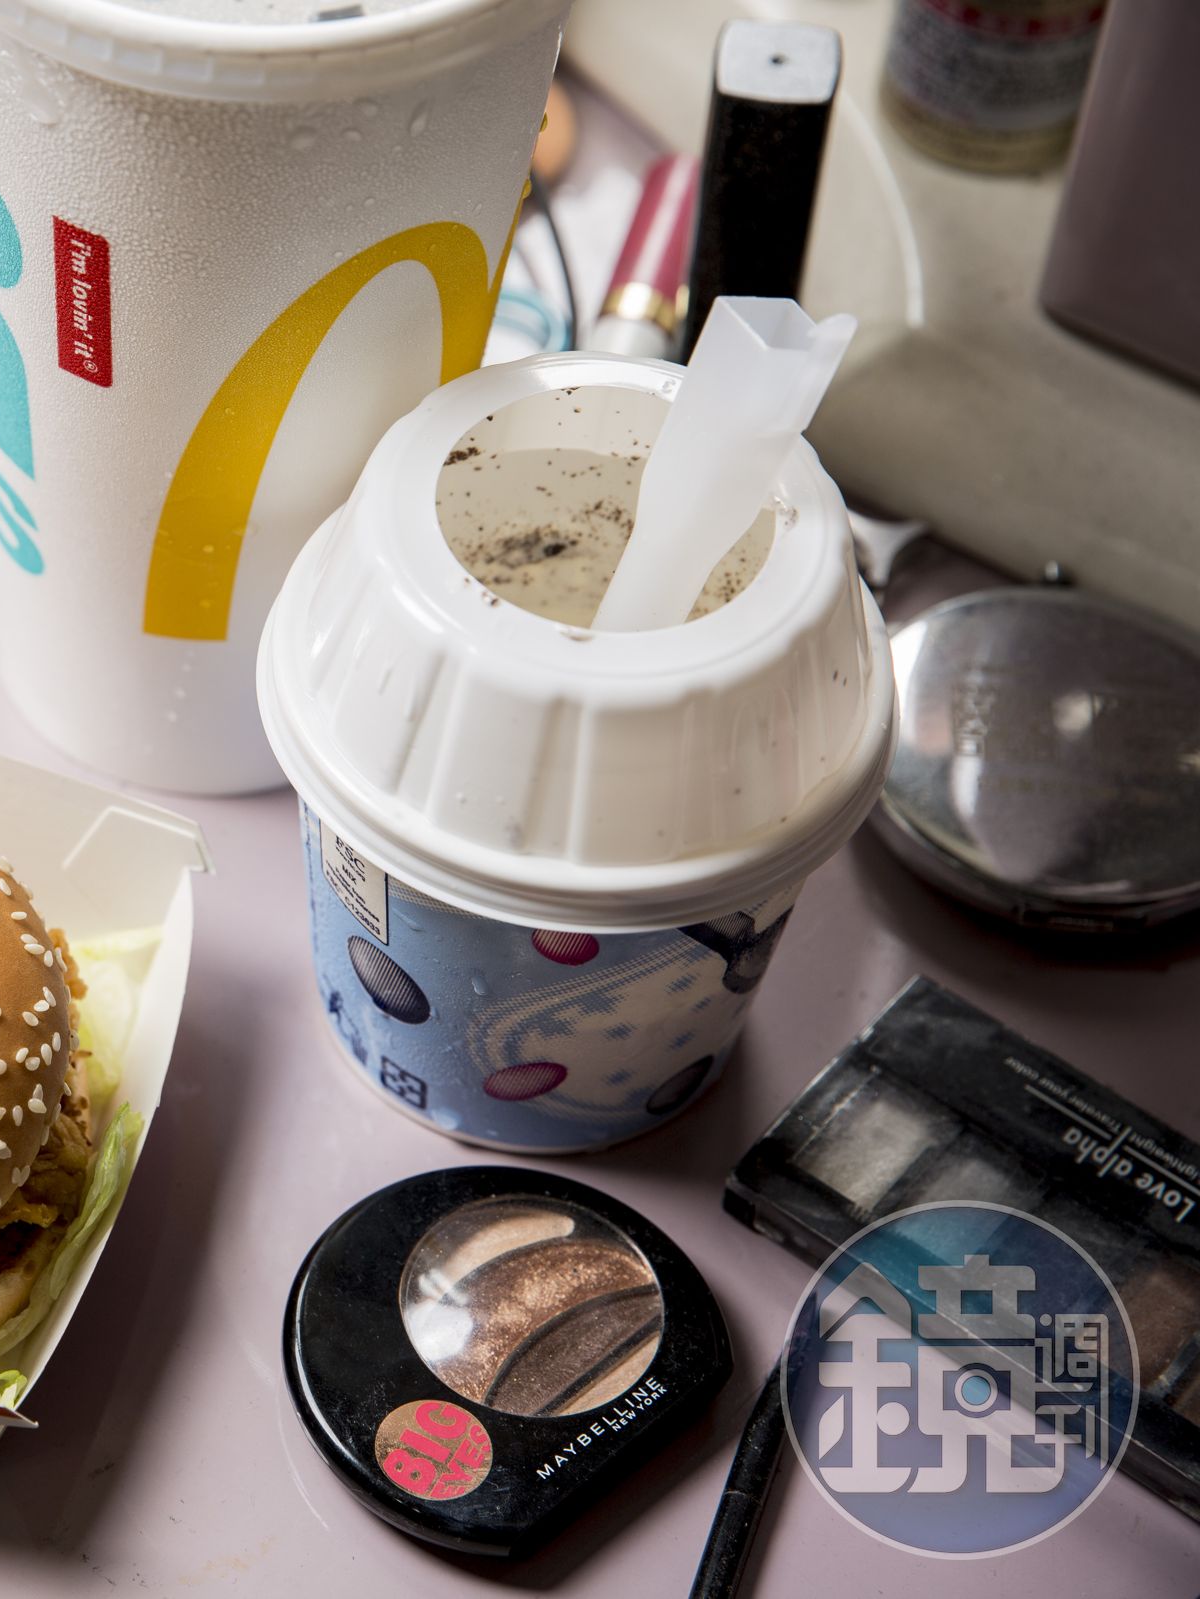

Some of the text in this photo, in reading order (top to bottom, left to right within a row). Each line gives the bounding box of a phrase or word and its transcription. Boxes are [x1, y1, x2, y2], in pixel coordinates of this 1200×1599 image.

[72, 278, 94, 340] lovin'
[1062, 1125, 1195, 1223] Love alpha
[1129, 1132, 1200, 1184] ightweight
[536, 1377, 661, 1480] MAYBELLINE
[611, 1386, 667, 1432] NEW YORK
[382, 1400, 471, 1498] BIG
[427, 1424, 491, 1499] EYES
